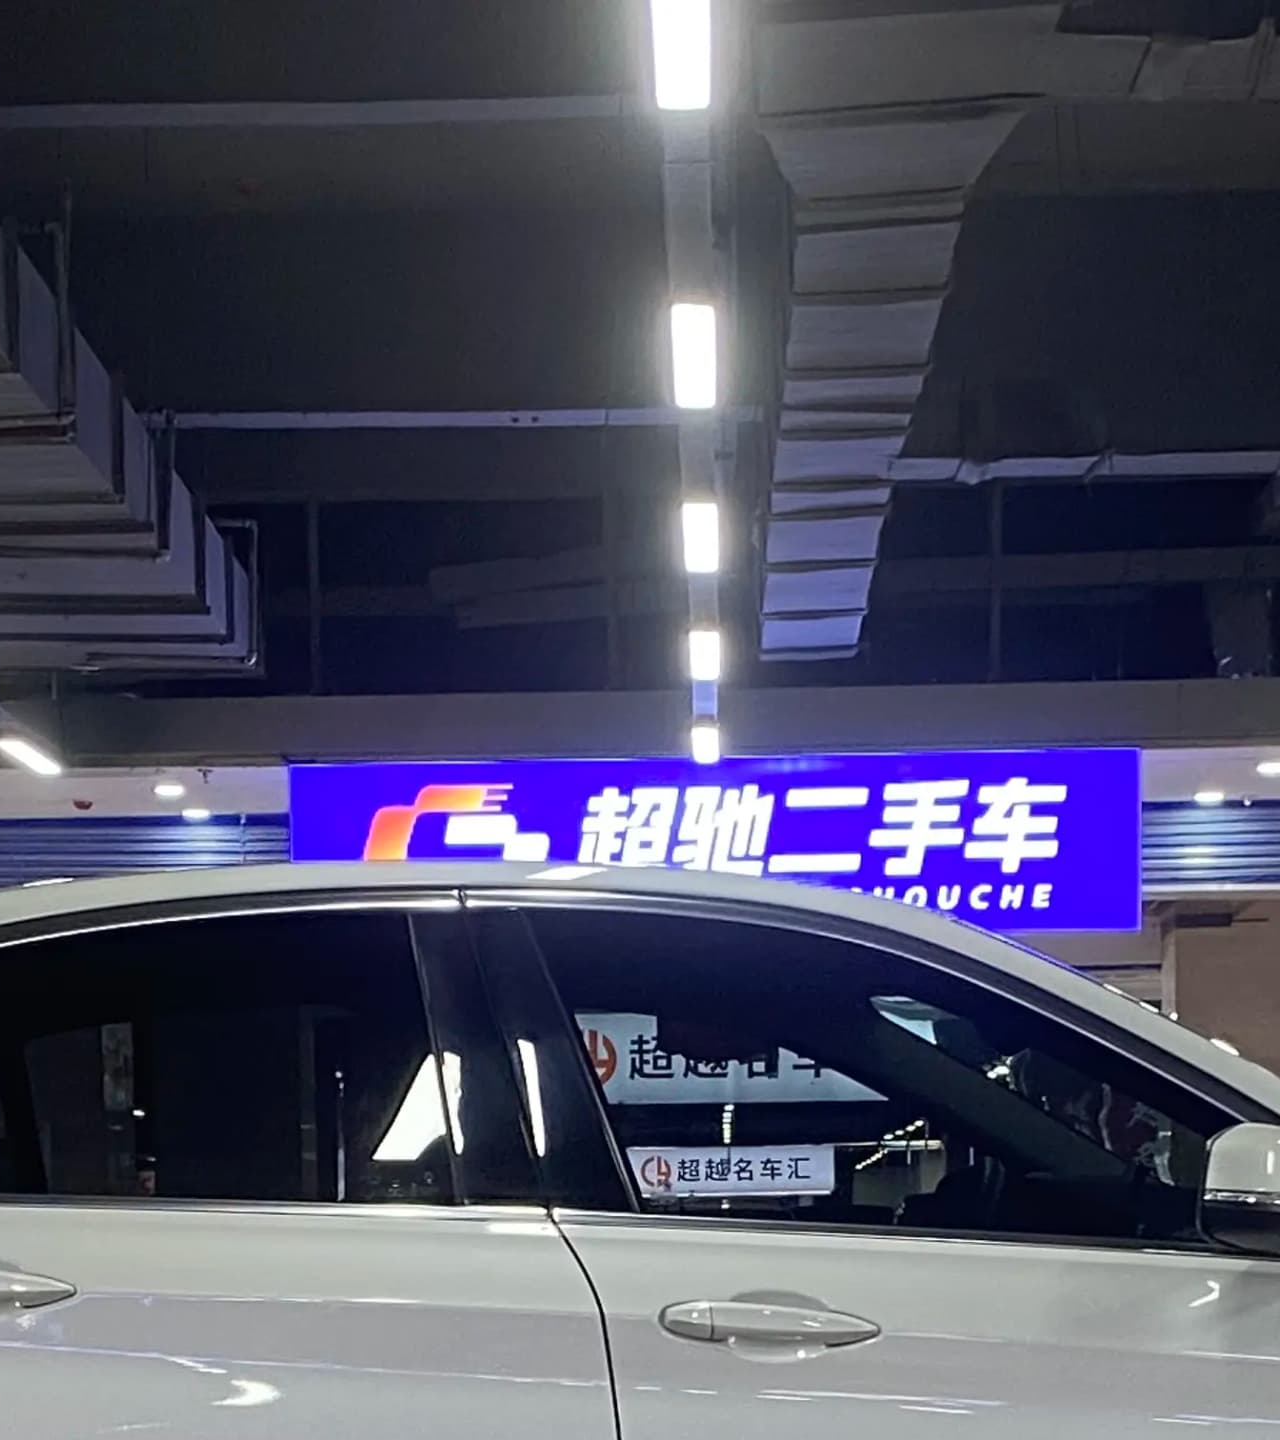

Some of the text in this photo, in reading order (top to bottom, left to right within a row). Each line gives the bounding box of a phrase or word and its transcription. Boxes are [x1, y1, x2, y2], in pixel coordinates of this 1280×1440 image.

[577, 777, 1068, 876] 超驰二手车
[850, 883, 1053, 910] OUCHE
[677, 1157, 812, 1183] 超越名车汇
